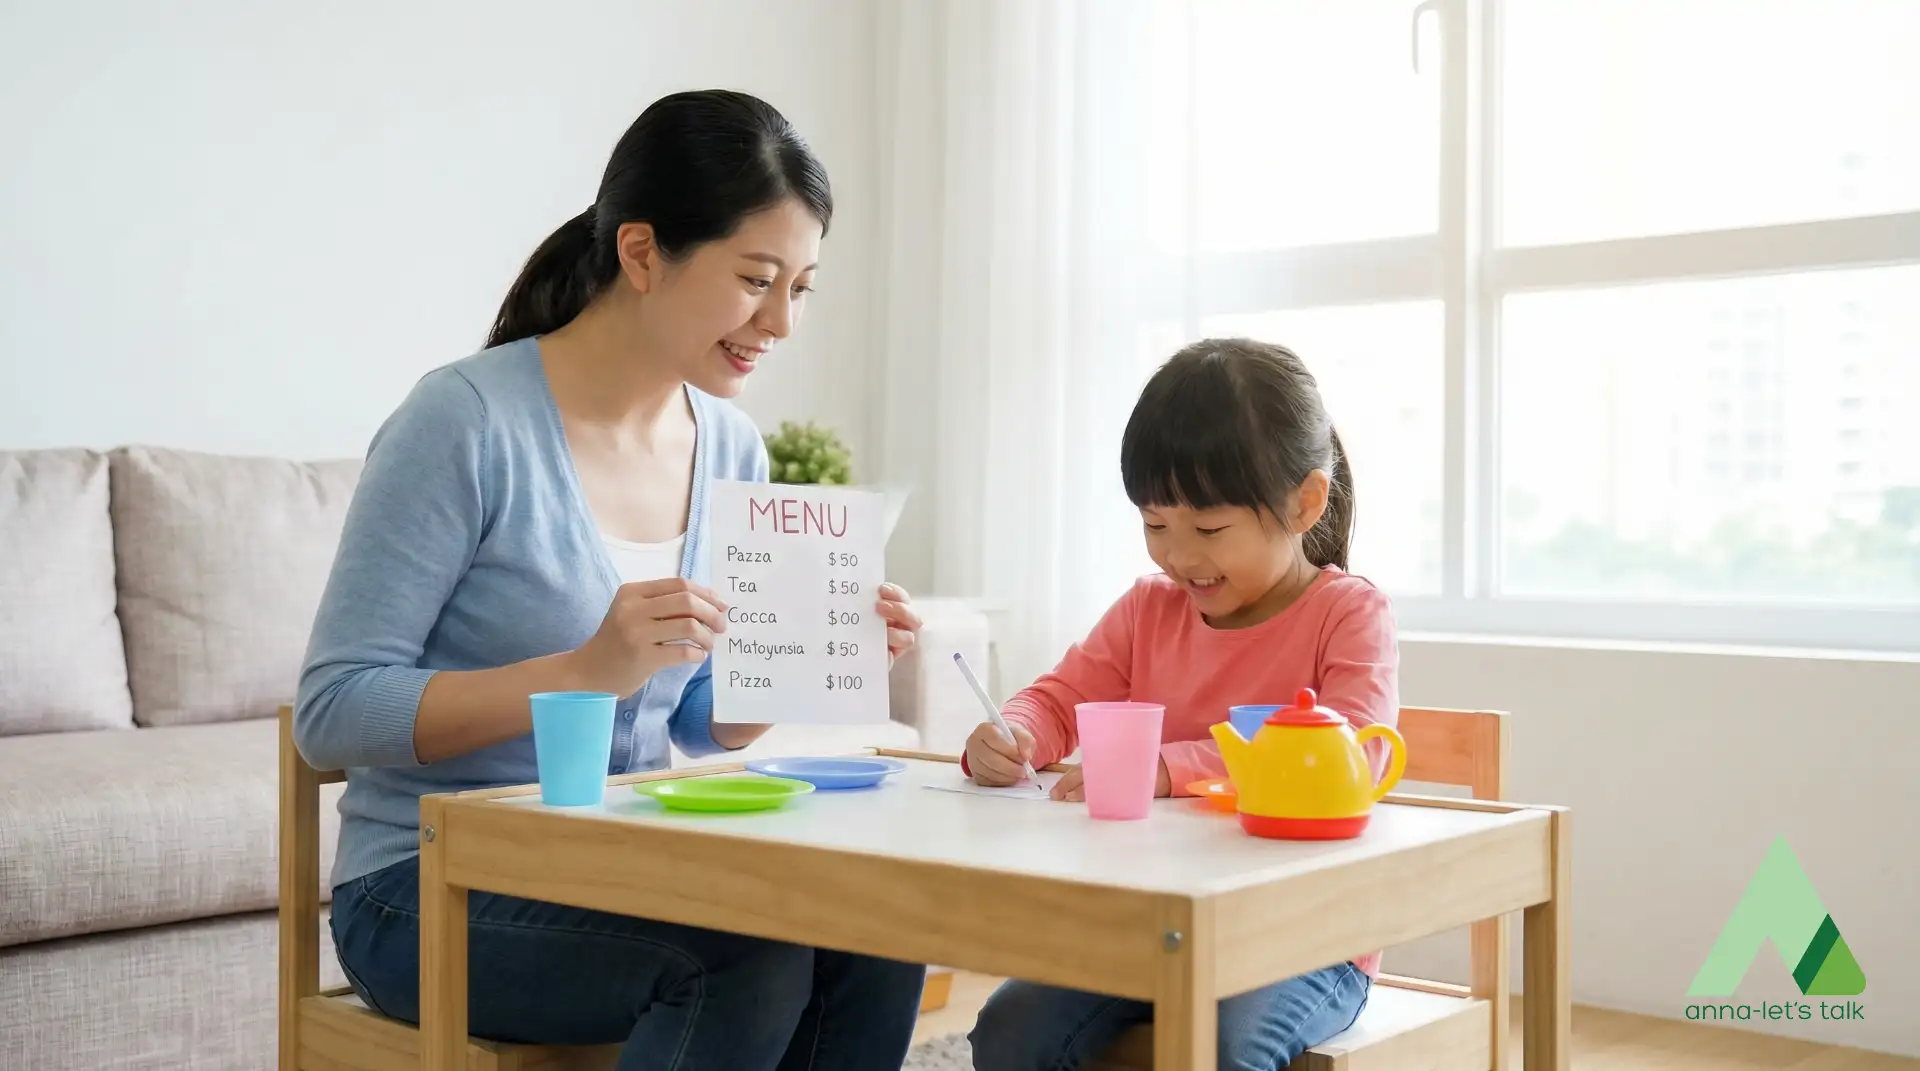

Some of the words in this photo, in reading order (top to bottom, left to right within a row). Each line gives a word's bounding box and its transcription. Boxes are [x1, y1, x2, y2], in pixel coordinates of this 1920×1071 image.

[749, 497, 846, 537] MENU
[728, 546, 771, 562] Pazza
[728, 577, 757, 592] Tea
[728, 607, 777, 623] Cocca
[730, 671, 772, 687] Pizza
[826, 673, 862, 690] $100
